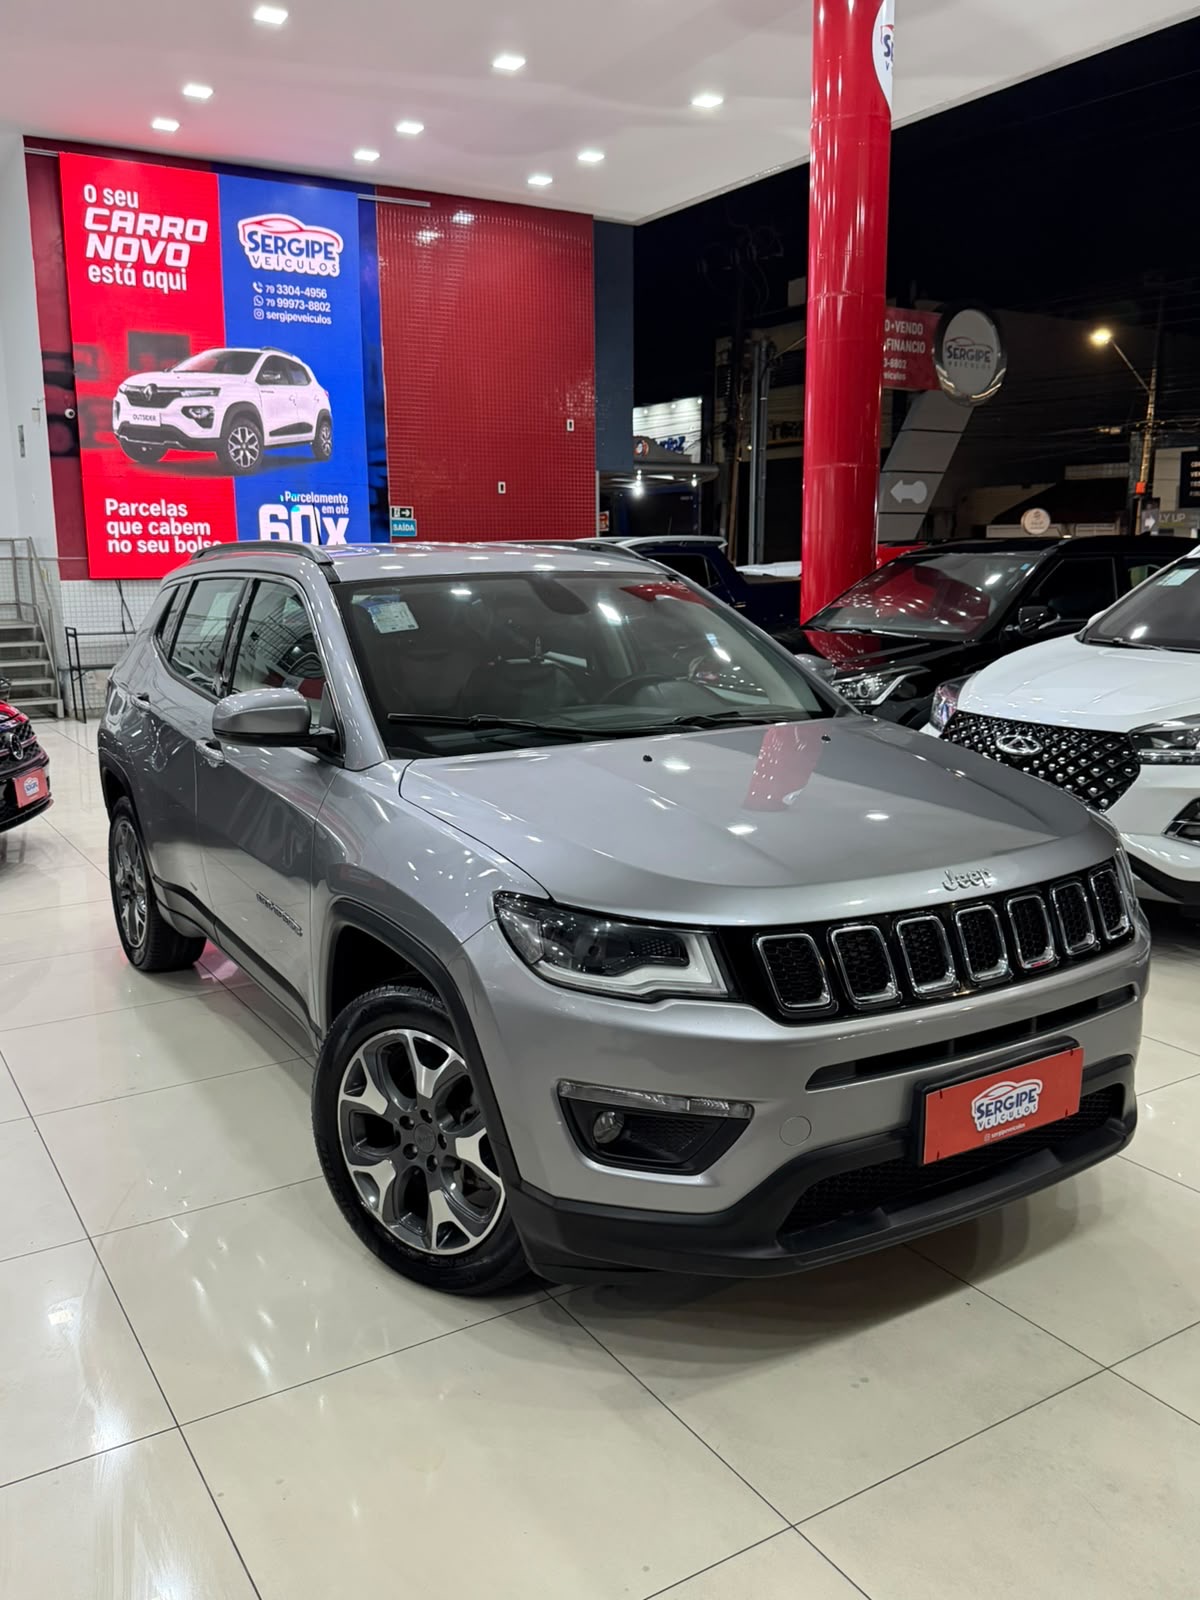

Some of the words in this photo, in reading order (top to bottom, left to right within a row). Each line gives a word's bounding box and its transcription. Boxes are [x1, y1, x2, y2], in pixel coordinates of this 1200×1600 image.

[83, 183, 97, 204] O
[103, 188, 139, 209] seu
[84, 206, 208, 243] CARRO
[85, 232, 191, 268] NOVO
[247, 230, 336, 261] SERGIPE
[87, 263, 137, 286] está
[142, 268, 187, 295] aqui
[276, 284, 327, 299] 3304-4956
[276, 298, 331, 312] 99973-8802
[266, 310, 332, 325] sergipeveiculos
[946, 345, 991, 363] SERGIPE
[284, 490, 349, 504] Parcelamento
[105, 498, 188, 517] Parcelas
[321, 505, 335, 514] em
[335, 503, 350, 515] até
[106, 519, 144, 539] que
[148, 517, 211, 536] cabem
[258, 503, 350, 546] 60x
[392, 522, 415, 532] SAÍDA
[108, 538, 132, 553] no
[137, 538, 170, 553] seu
[942, 868, 992, 892] Jeep
[975, 1088, 1038, 1121] SERGIPE
